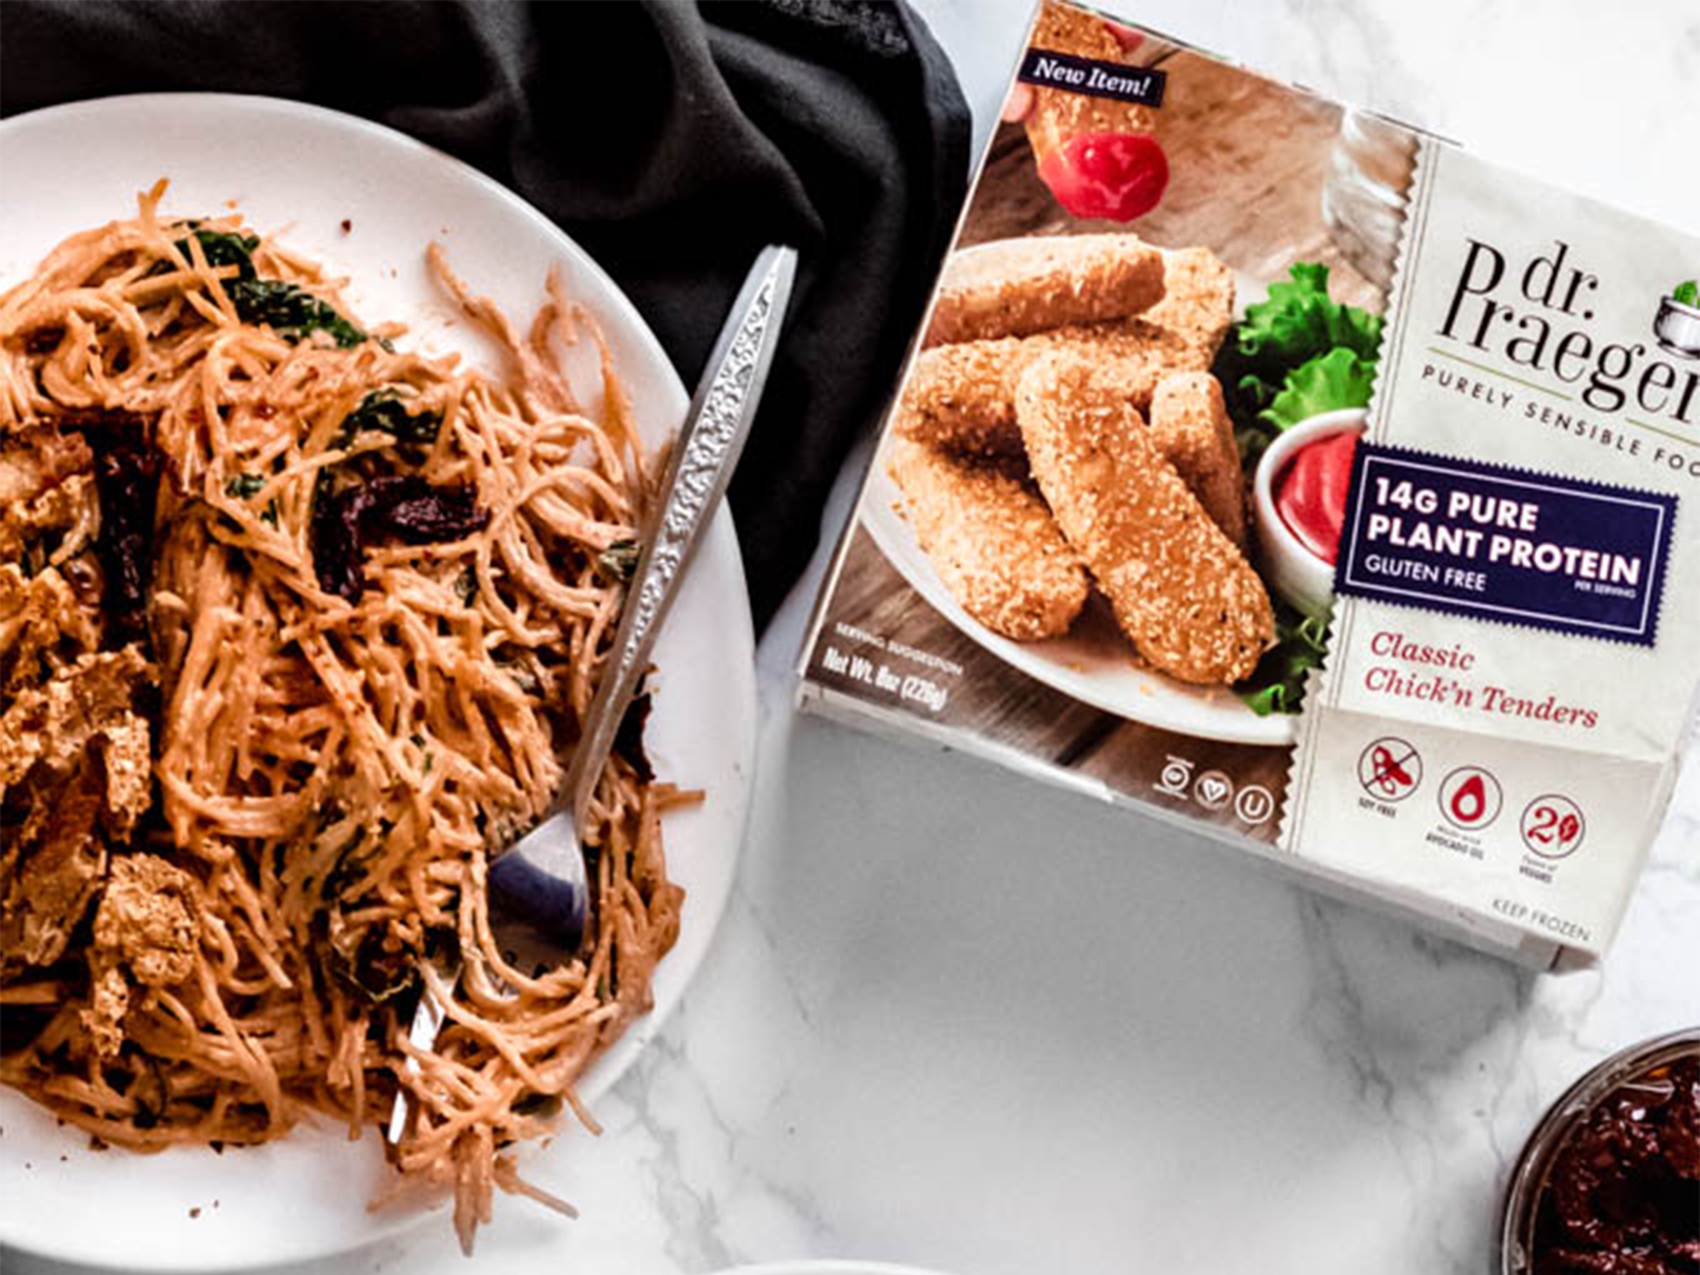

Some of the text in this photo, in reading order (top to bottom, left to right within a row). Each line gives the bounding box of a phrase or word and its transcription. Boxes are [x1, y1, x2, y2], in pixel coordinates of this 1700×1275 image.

[1033, 57, 1152, 96] New Item!
[1520, 240, 1599, 320] dr.
[1421, 365, 1513, 409] PURELY
[1524, 402, 1642, 456] SENSIBLE
[1375, 477, 1539, 532] 14G PURE
[1367, 514, 1641, 585] PLANT PROTEIN
[1364, 553, 1487, 592] GLUTEN FREE
[822, 646, 849, 674] Net
[1370, 631, 1475, 671] Classic
[1482, 686, 1599, 729] Tenders
[1492, 898, 1590, 942] KEEP FROZEN
